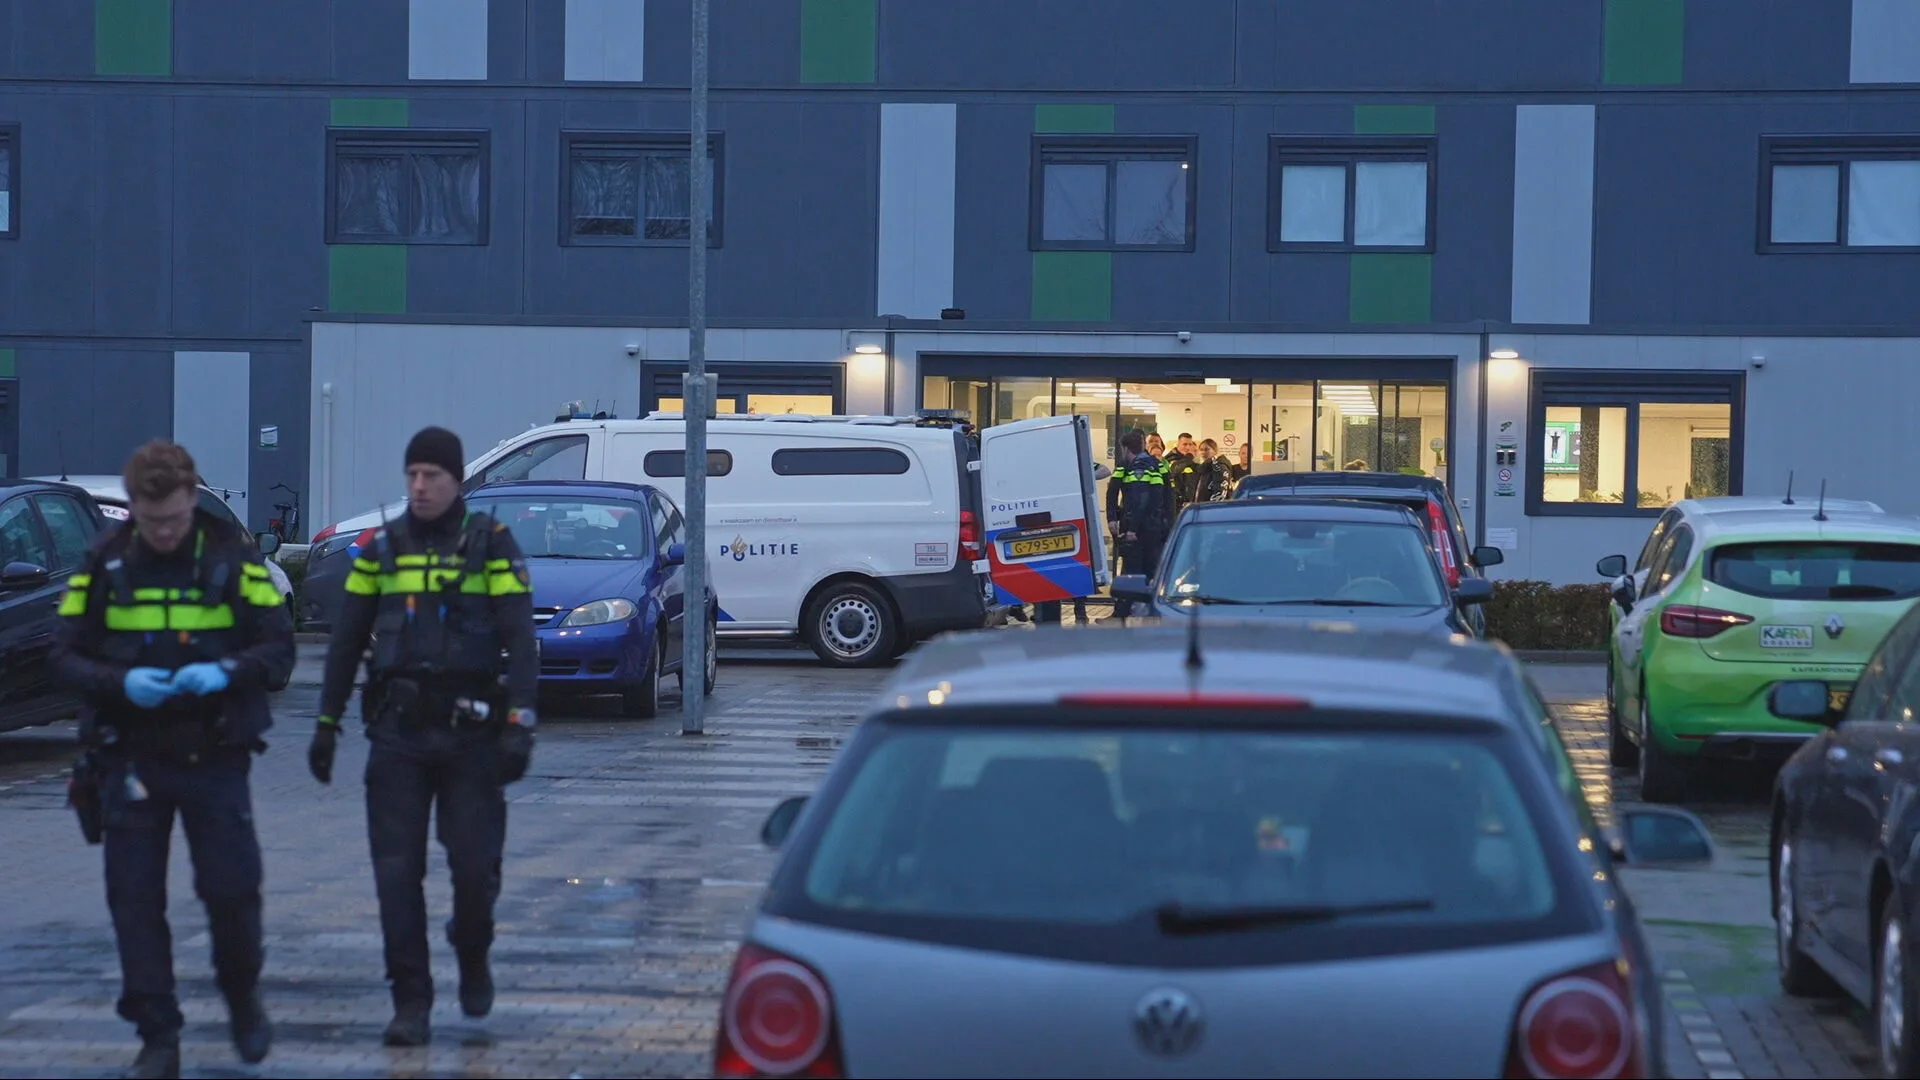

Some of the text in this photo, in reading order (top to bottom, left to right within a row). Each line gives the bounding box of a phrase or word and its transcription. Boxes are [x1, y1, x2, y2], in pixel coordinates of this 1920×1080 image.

[991, 500, 1039, 512] POLITIE
[720, 543, 799, 562] POLITIE
[1014, 537, 1068, 554] G-795-VT
[1763, 628, 1809, 639] KAFRA
